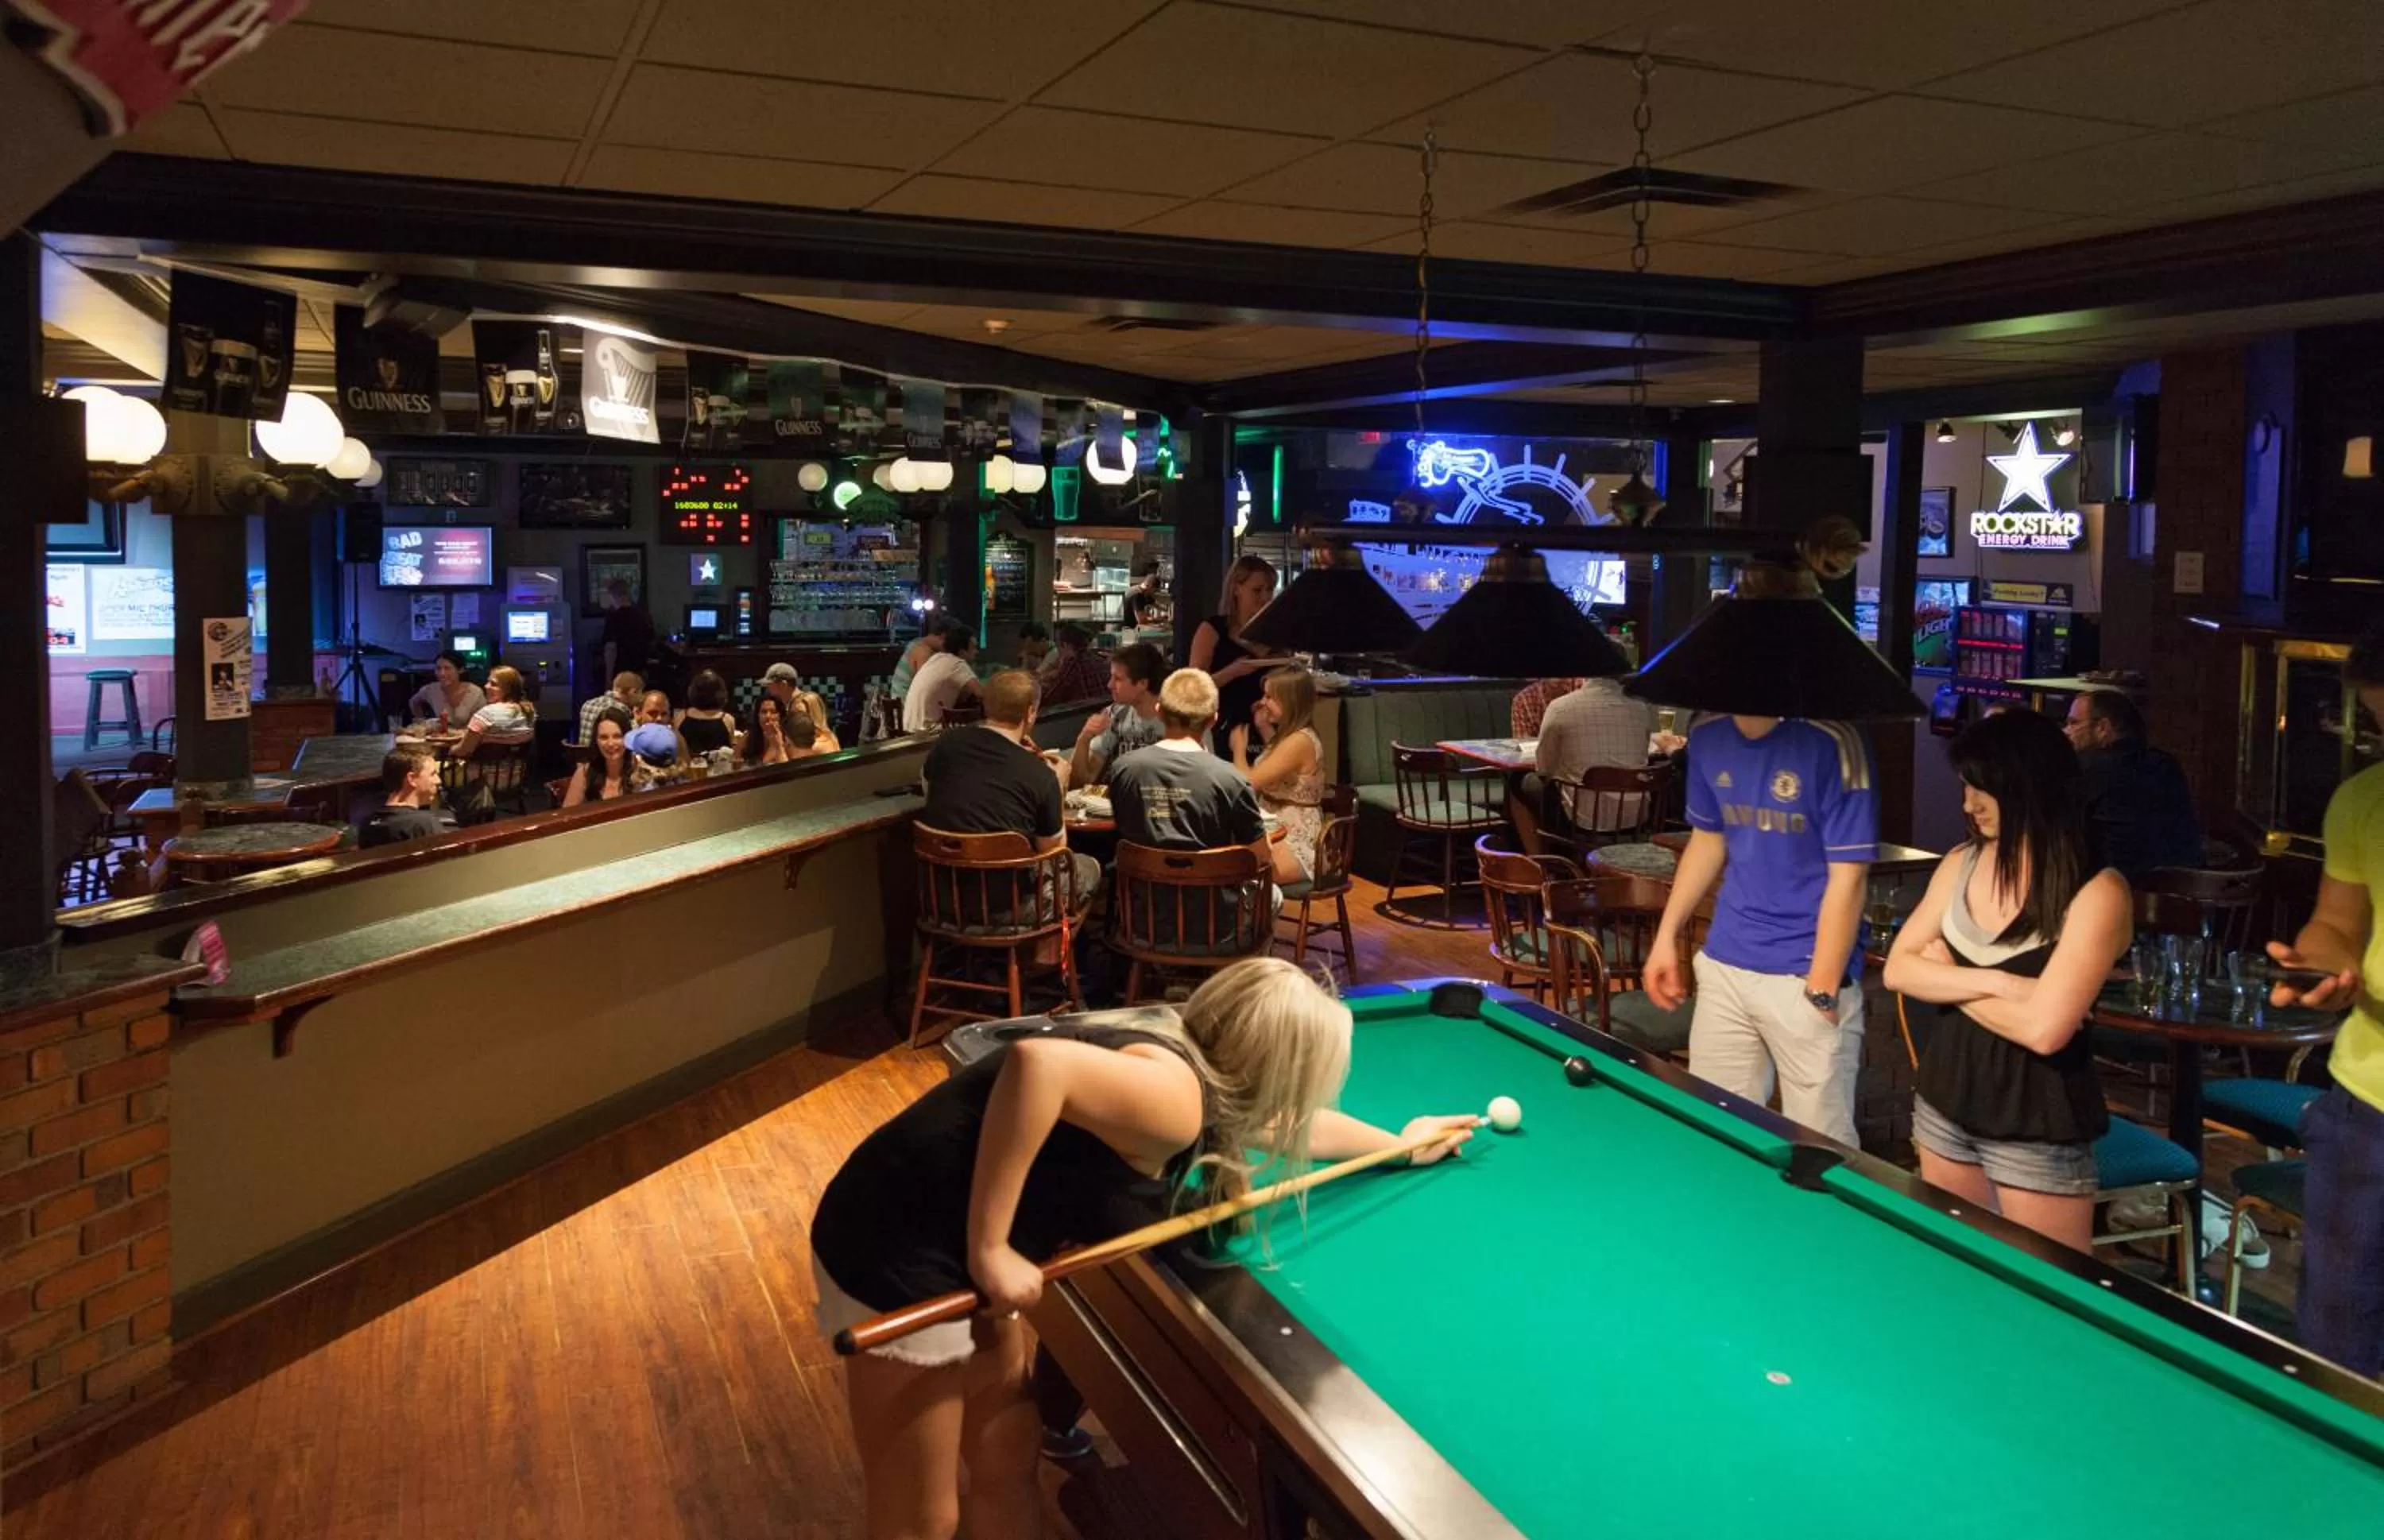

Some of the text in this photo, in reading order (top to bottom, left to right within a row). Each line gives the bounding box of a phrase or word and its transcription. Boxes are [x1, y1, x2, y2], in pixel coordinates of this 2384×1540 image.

[348, 386, 432, 413] GUINNESS
[775, 419, 823, 436] GUINNESS
[1971, 512, 2080, 535] ROCKSTAR
[1978, 534, 2069, 546] ENERGY DRINK
